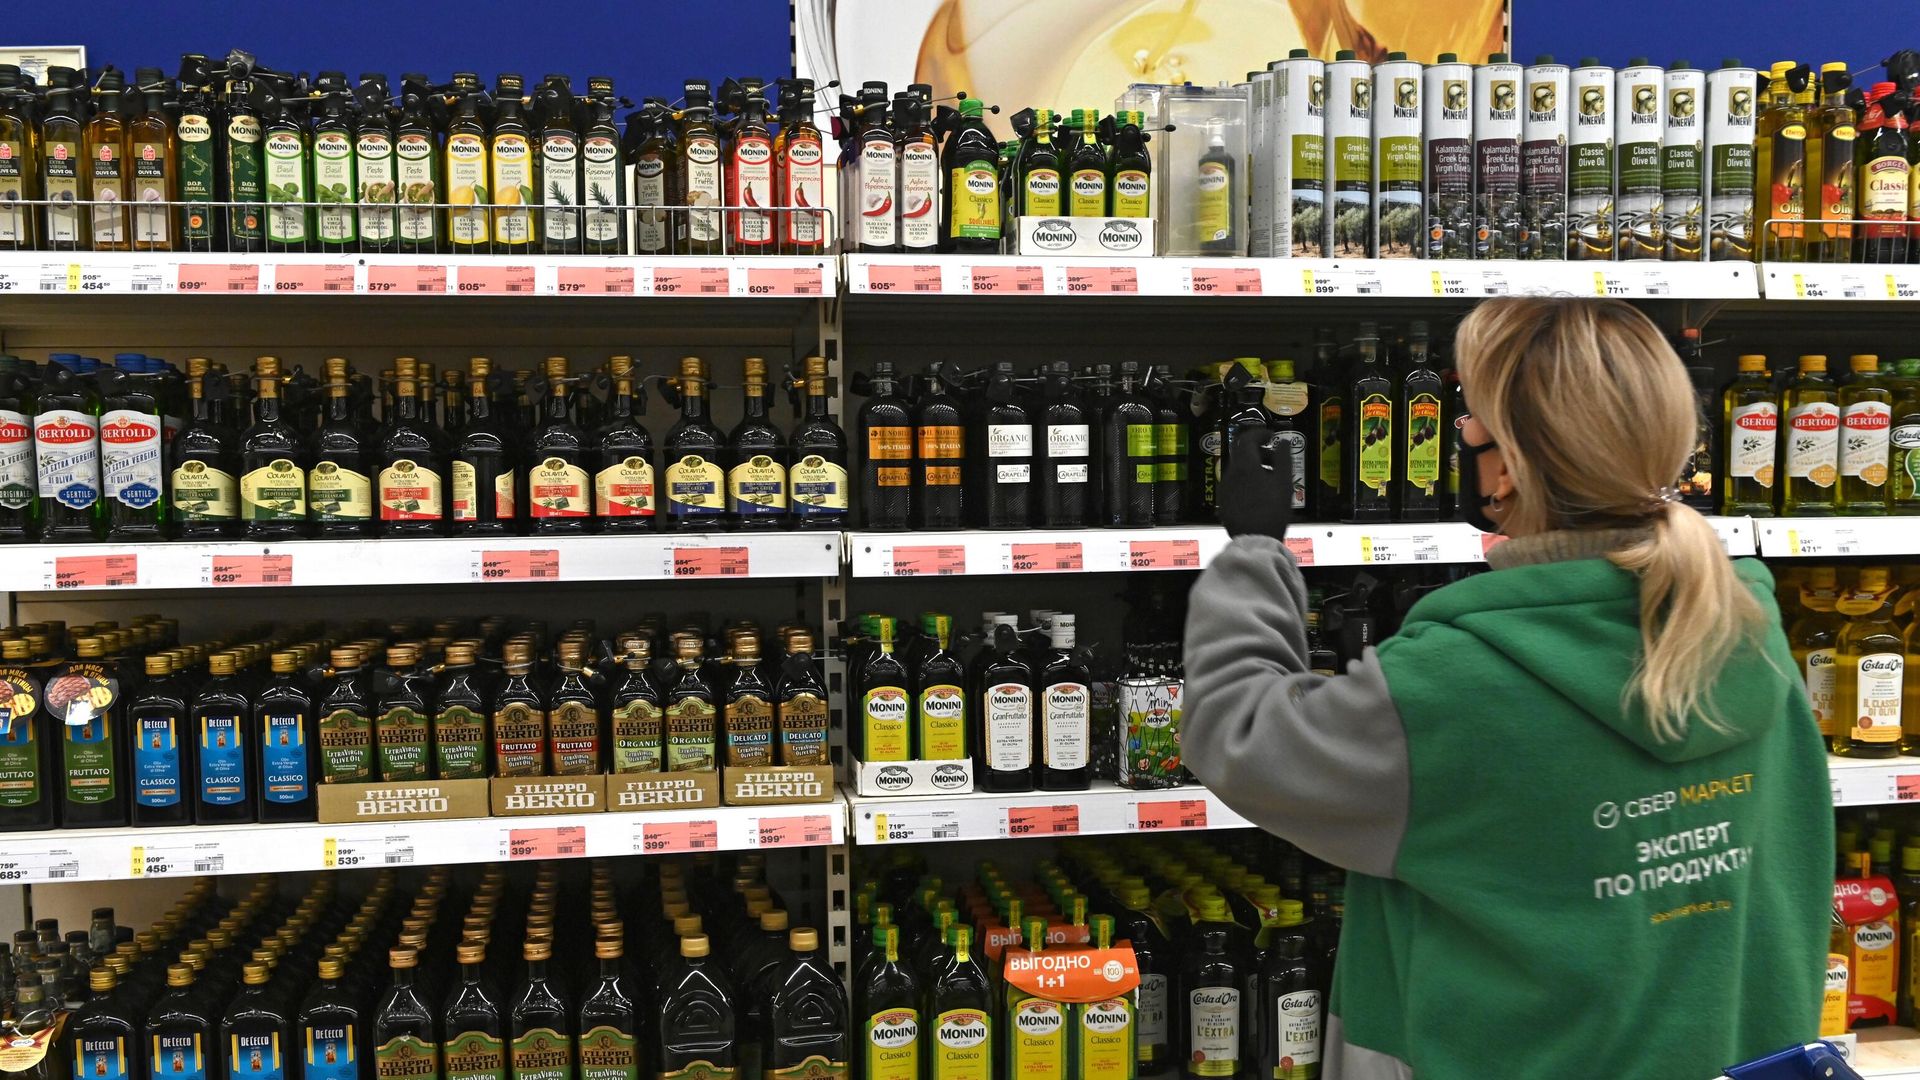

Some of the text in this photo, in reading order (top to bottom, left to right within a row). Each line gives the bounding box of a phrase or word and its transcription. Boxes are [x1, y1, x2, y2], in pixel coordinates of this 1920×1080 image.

[179, 127, 209, 135] MONINI
[451, 145, 479, 153] MONINI
[545, 145, 573, 153] MONINI
[1581, 148, 1604, 156] Classic
[1633, 147, 1656, 155] Classic
[1729, 148, 1750, 156] Classic
[1579, 158, 1595, 166] Olive
[1632, 157, 1648, 165] Olive
[968, 180, 993, 188] MONINI
[1075, 182, 1102, 190] MONINI
[1036, 232, 1073, 242] MONINI
[1103, 233, 1140, 243] MONINI
[1795, 418, 1838, 426] BERTOLLI
[1847, 417, 1888, 425] BERTOLLI
[39, 428, 90, 438] BERTOLLI
[103, 428, 151, 437] BERTOLLI
[994, 696, 1026, 704] MONINI
[1052, 695, 1084, 703] MONINI
[870, 703, 905, 712] MONINI
[926, 701, 961, 710] MONINI
[728, 722, 772, 731] BERIO
[782, 719, 827, 729] BERIO
[874, 722, 901, 730] Classico
[931, 720, 958, 728] Classico
[496, 729, 541, 738] BERIO
[552, 729, 597, 737] BERIO
[321, 737, 369, 746] BERIO
[381, 734, 426, 744] BERIO
[437, 734, 483, 743] BERIO
[734, 734, 766, 742] DELICATO
[141, 778, 175, 786] CLASSICO
[206, 776, 240, 784] CLASSICO
[269, 774, 303, 782] CLASSICO
[744, 773, 814, 782] FILIPPO
[935, 775, 965, 783] MONINI
[515, 784, 587, 794] FILIPPO
[626, 780, 695, 790] FILIPPO
[736, 781, 821, 797] BERIO
[365, 789, 439, 800] FILIPPO
[618, 789, 703, 805] BERIO
[1625, 773, 1754, 817] СБЕР МАРКЕТ
[357, 797, 448, 815] BERIO
[506, 793, 594, 810] BERIO
[1636, 822, 1730, 862] ЭКСПЕРТ
[1594, 874, 1635, 898] ПО
[991, 932, 1066, 946] ВЫГНО
[1857, 931, 1891, 943] MONINI
[1011, 956, 1090, 972] ВЫГОДНО
[1824, 971, 1847, 981] NINI
[1036, 975, 1065, 988] 1+1
[1193, 992, 1237, 1004] Costa d'Oro
[1281, 998, 1303, 1010] Costa
[1019, 1016, 1059, 1025] MONINI
[1086, 1013, 1126, 1024] MONINI
[874, 1026, 916, 1040] MONINI
[940, 1029, 985, 1040] MONINI
[1197, 1026, 1234, 1037] L'EXTRA
[1091, 1036, 1121, 1044] Classico
[451, 1055, 497, 1063] FILIPPO
[519, 1052, 565, 1060] FILIPPO
[582, 1056, 632, 1065] BERIO
[880, 1051, 911, 1061] Classico
[946, 1052, 979, 1060] Classico
[383, 1060, 429, 1068] FILIPPO
[448, 1061, 500, 1071] BERIO
[516, 1059, 568, 1068] BERIO
[380, 1066, 432, 1076] BERIO
